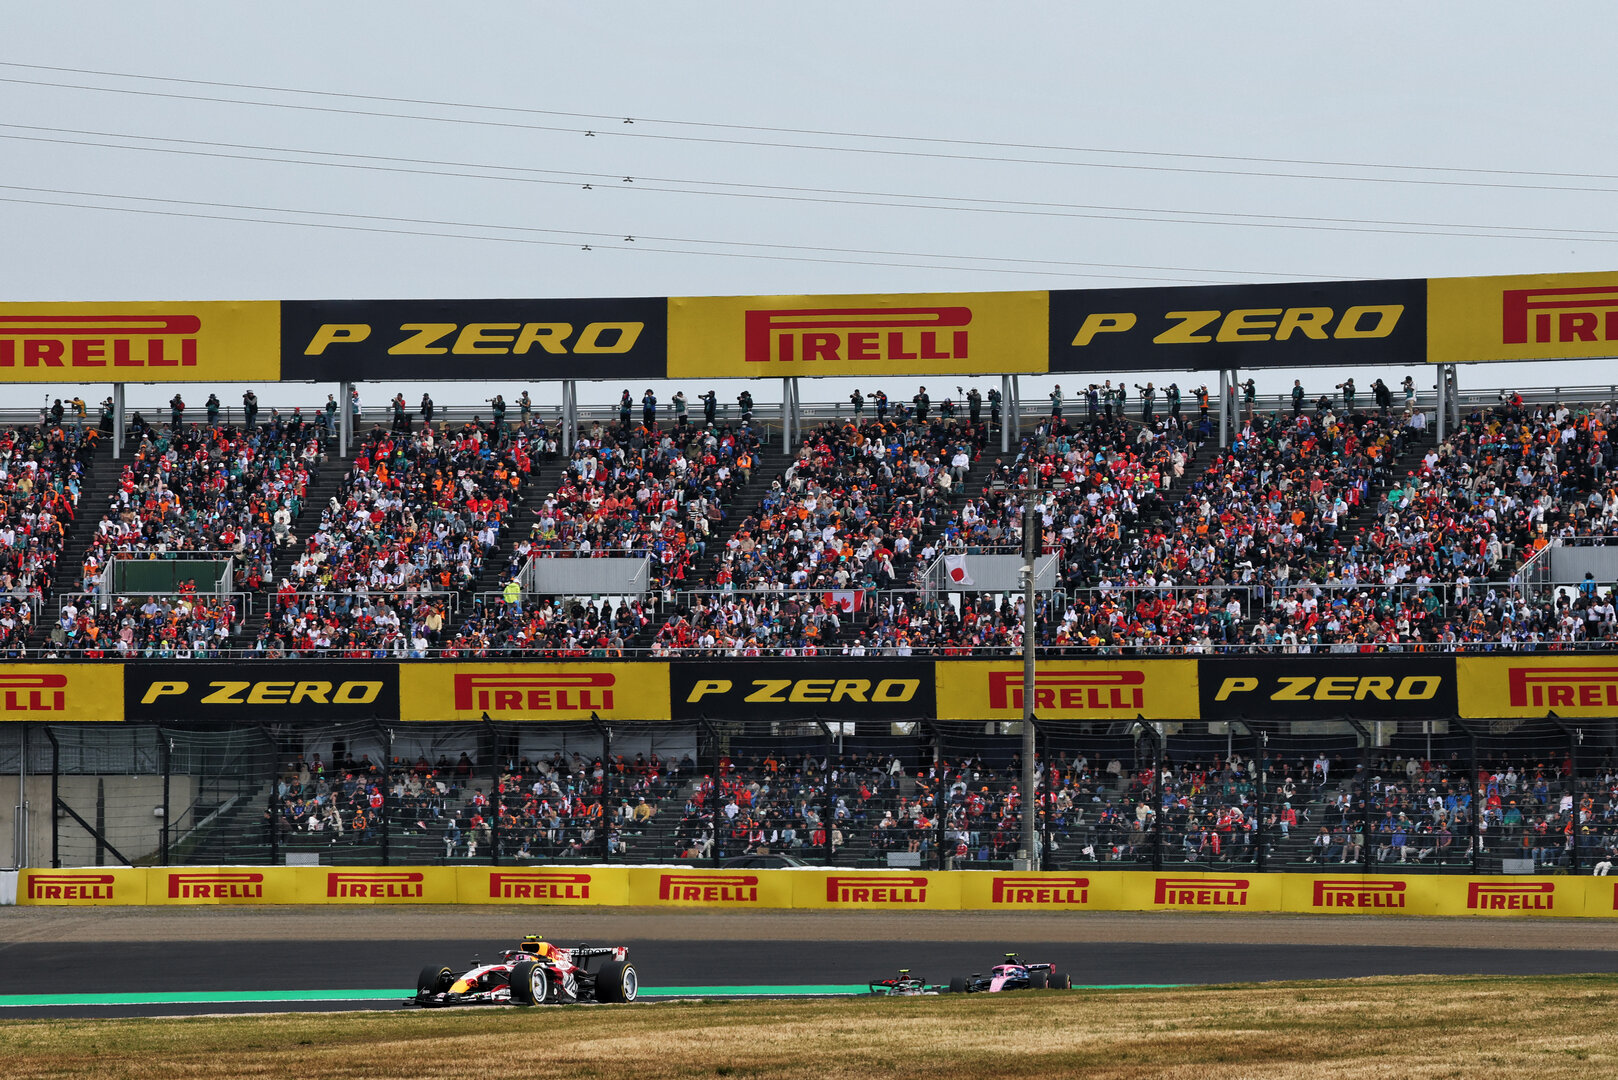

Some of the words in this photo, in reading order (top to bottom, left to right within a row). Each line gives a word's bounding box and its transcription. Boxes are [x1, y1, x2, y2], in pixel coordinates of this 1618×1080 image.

[746, 307, 971, 361] PIRELLI
[1072, 312, 1137, 346] P
[1153, 304, 1405, 344] ZERO
[303, 323, 372, 355] P
[388, 322, 645, 354] ZERO
[140, 681, 188, 704] P
[201, 680, 384, 704] ZERO
[454, 673, 616, 710] PIRELLI
[686, 679, 733, 703] P
[744, 678, 921, 703] ZERO
[988, 671, 1145, 709] PIRELLI
[1214, 677, 1259, 701] P
[1270, 675, 1442, 701] ZERO
[29, 874, 115, 899] PIRELLI
[168, 873, 264, 898] PIRELLI
[327, 872, 424, 898] PIRELLI
[489, 873, 591, 899] PIRELLI
[659, 874, 759, 902] PIRELLI
[826, 877, 928, 903] PIRELLI
[992, 878, 1090, 903] PIRELLI
[1154, 878, 1250, 905] PIRELLI
[1312, 880, 1407, 907] PIRELLI
[1467, 882, 1555, 910] PIRELLI
